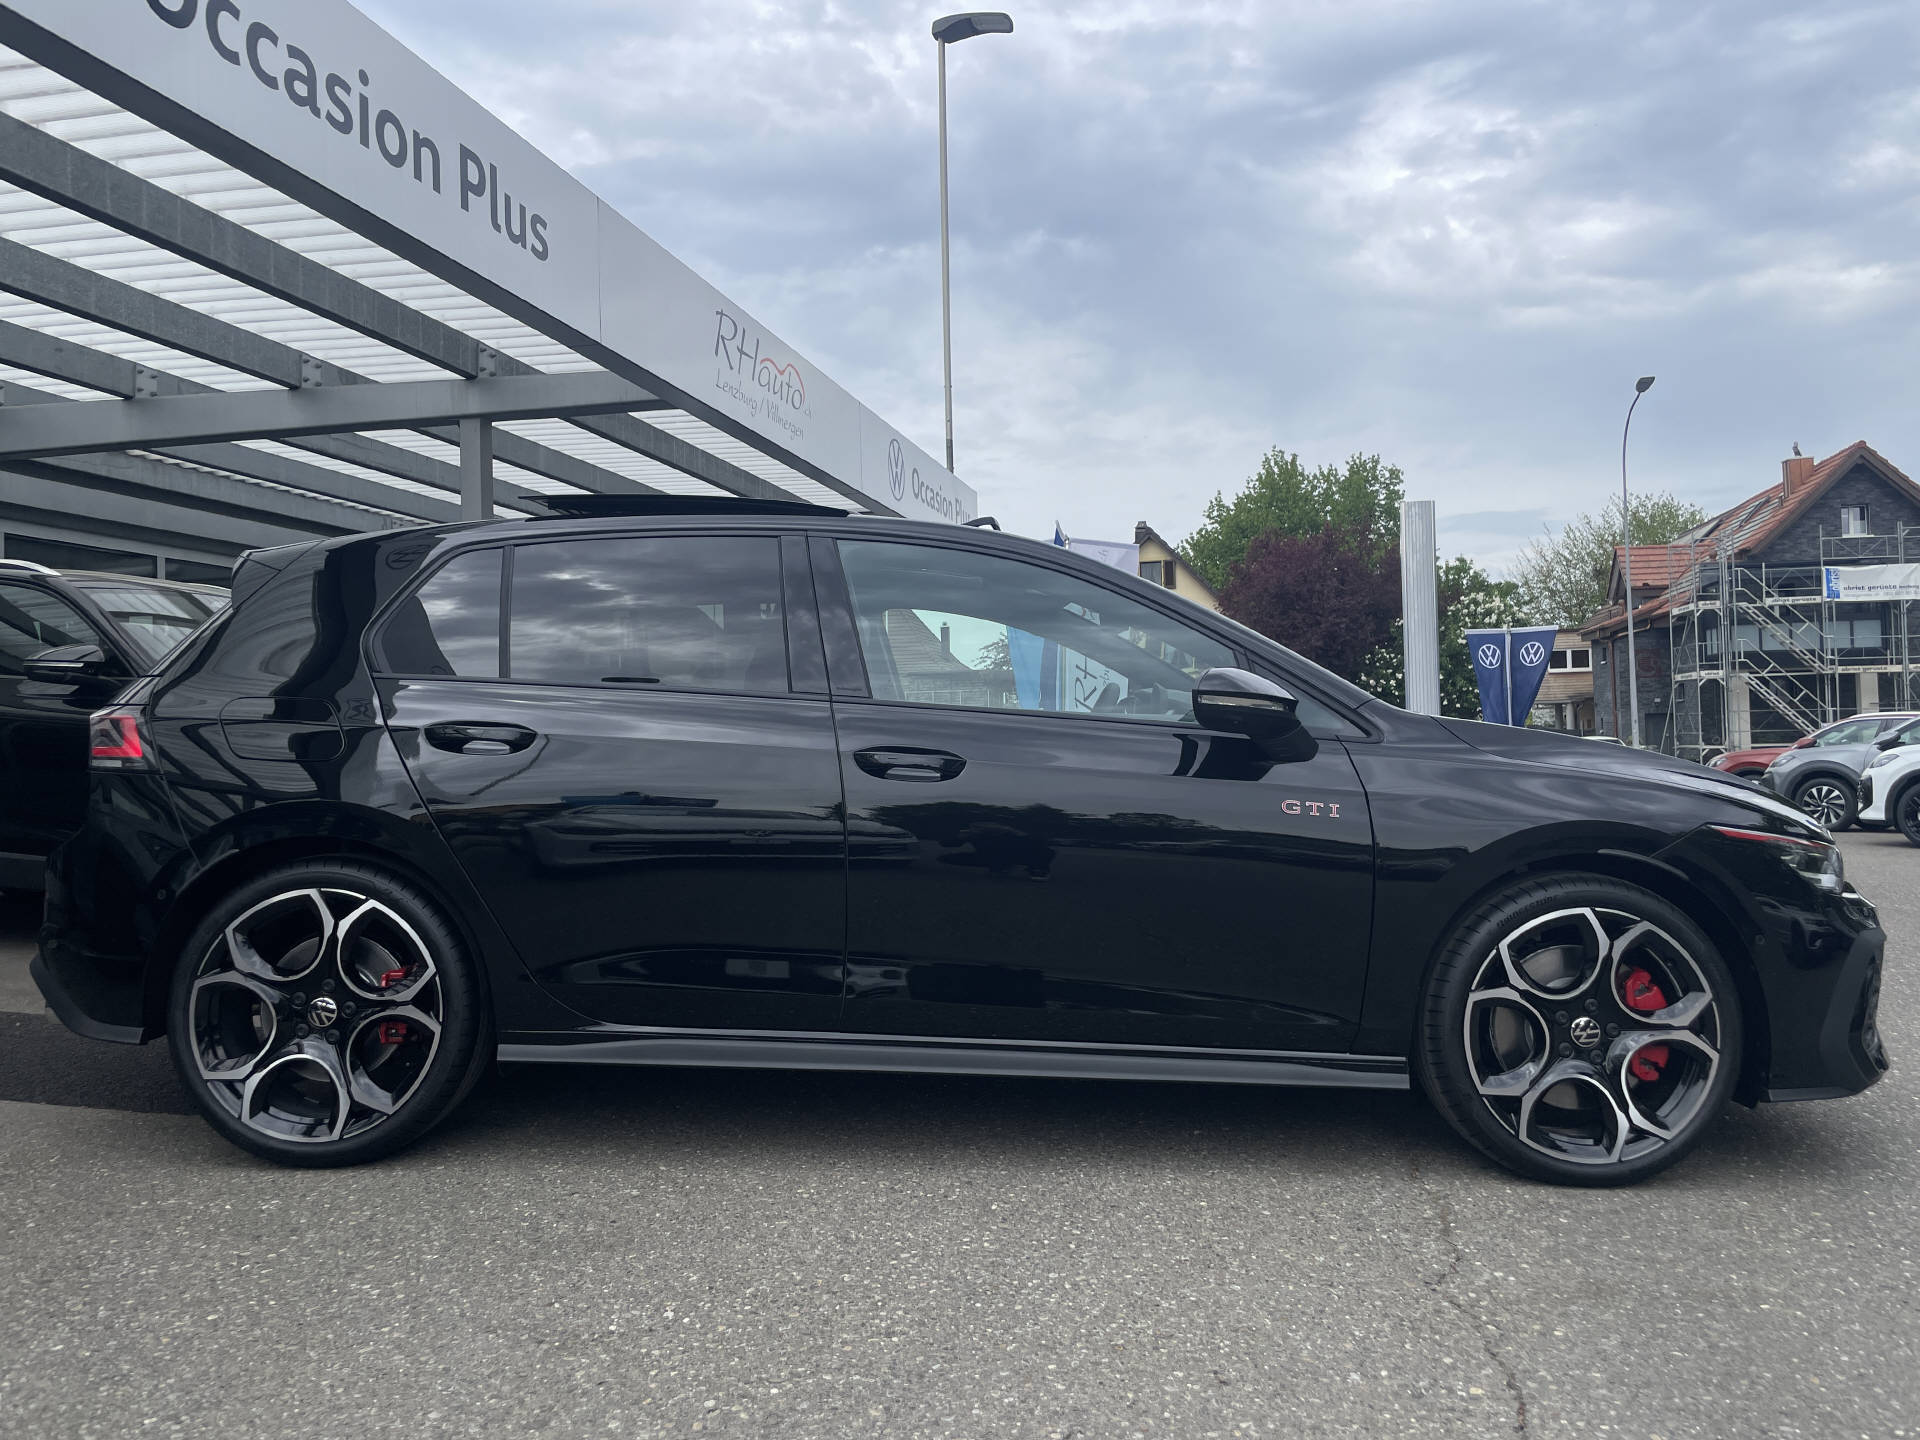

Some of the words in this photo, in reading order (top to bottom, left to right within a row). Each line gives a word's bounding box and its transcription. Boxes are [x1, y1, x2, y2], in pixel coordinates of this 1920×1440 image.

[458, 142, 550, 262] Plus
[715, 368, 758, 417] Lenzburg
[911, 467, 953, 520] Occasion
[1281, 799, 1340, 818] GTI
